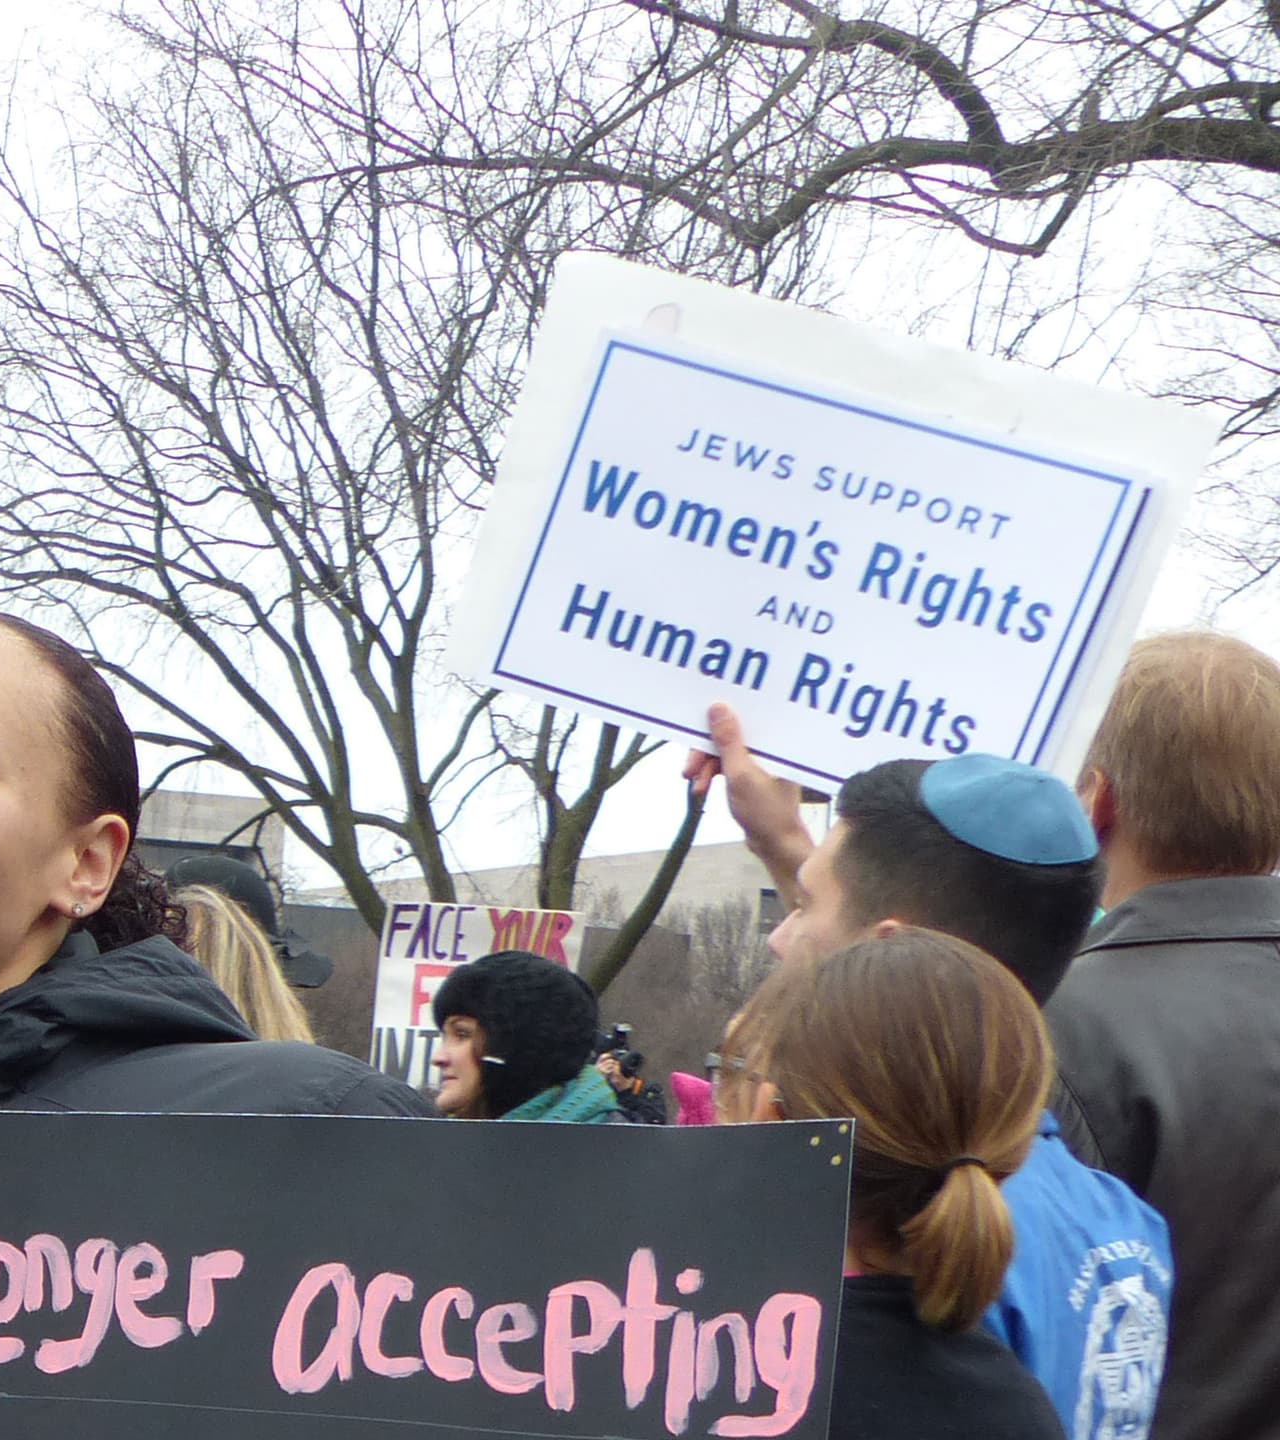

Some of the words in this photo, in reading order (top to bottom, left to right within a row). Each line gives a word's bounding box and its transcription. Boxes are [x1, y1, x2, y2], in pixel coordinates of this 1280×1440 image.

[581, 458, 843, 581] Women's
[858, 542, 1054, 645] Rights
[676, 427, 796, 483] JEWS
[813, 464, 1012, 542] SUPPORT
[559, 582, 771, 691] Human
[789, 652, 980, 756] Rights
[756, 594, 835, 636] AND
[384, 904, 476, 961] FACE
[488, 908, 573, 967] YOUR
[272, 1247, 822, 1439] accepting
